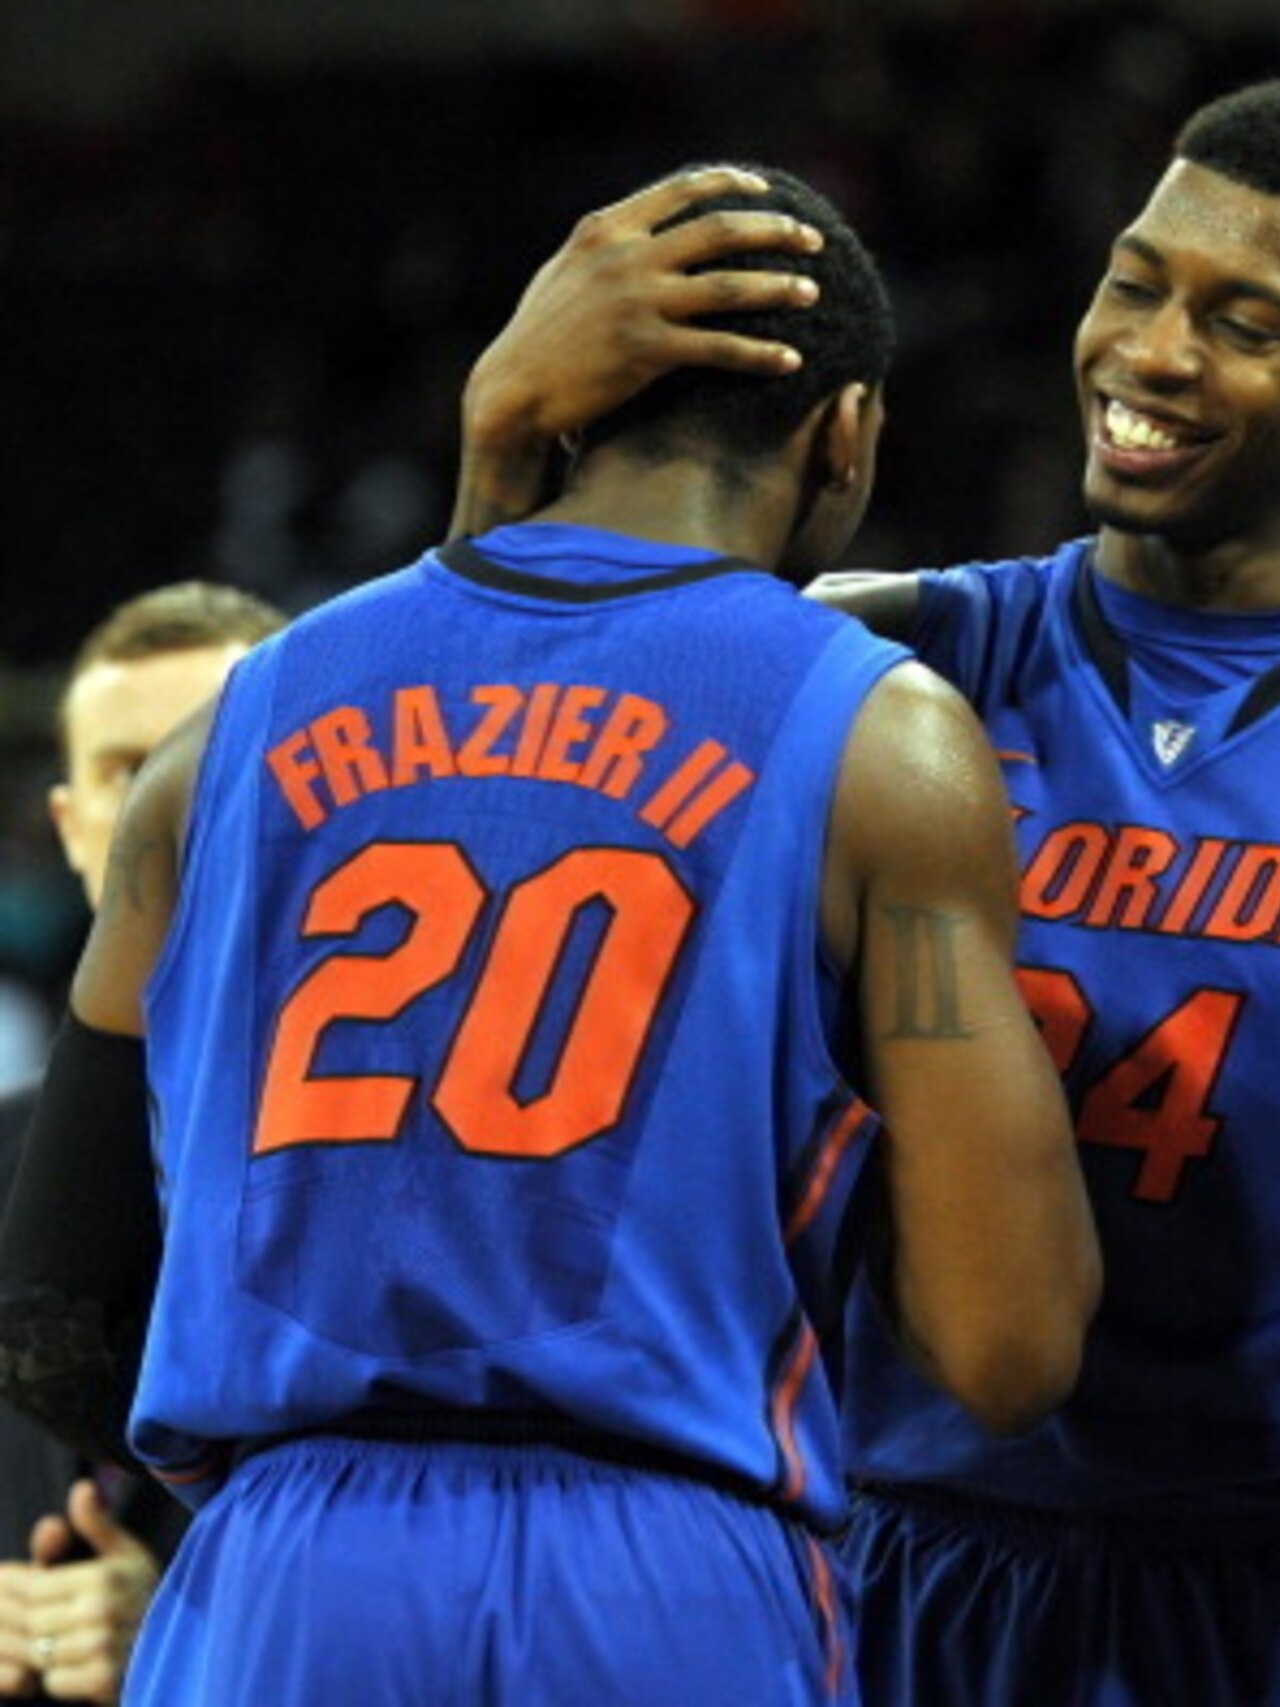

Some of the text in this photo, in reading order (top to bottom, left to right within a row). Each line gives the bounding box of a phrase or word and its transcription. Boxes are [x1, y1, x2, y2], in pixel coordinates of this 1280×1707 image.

[266, 684, 756, 850] FRAZIER II
[250, 839, 699, 1161] 20
